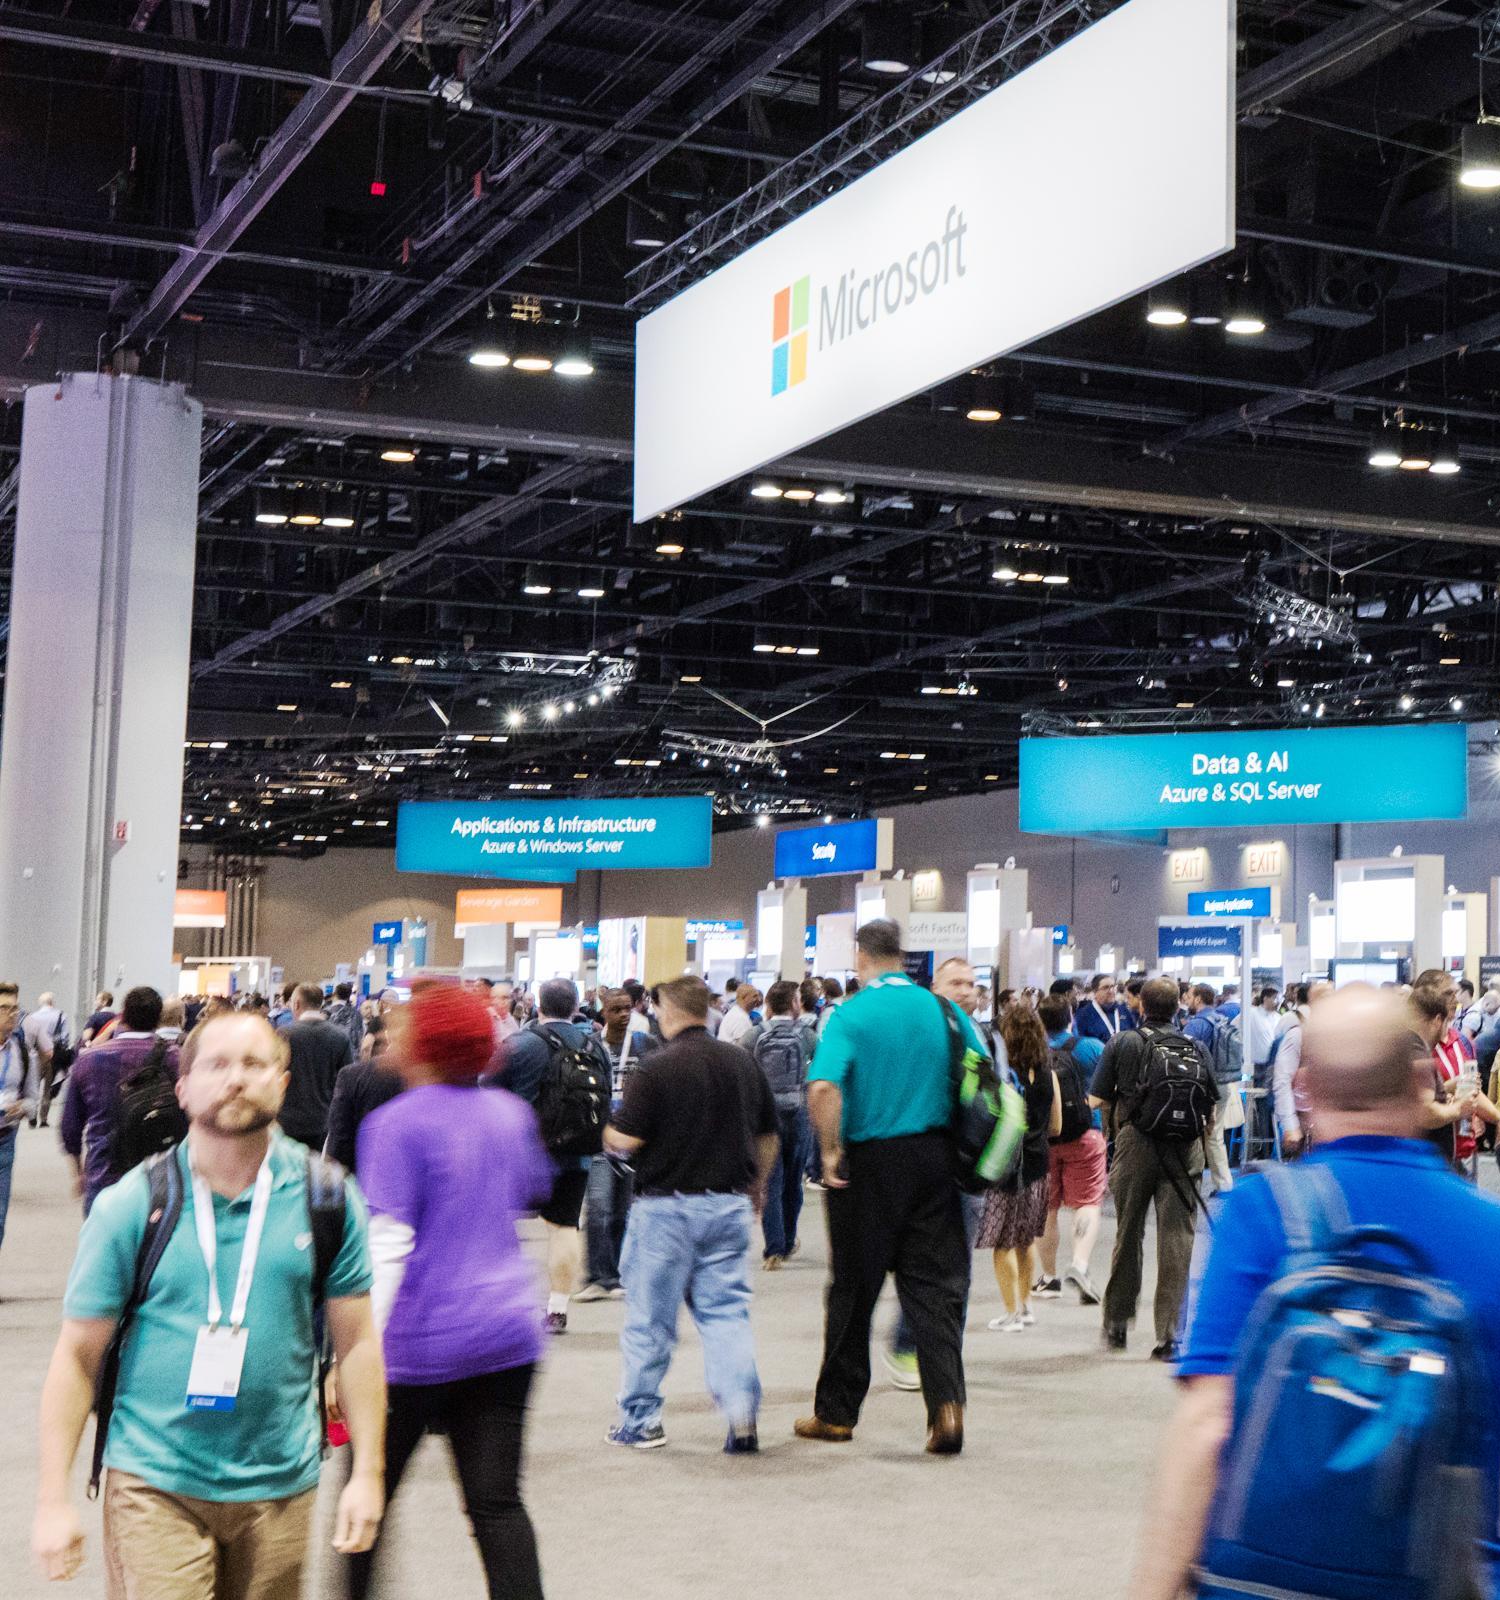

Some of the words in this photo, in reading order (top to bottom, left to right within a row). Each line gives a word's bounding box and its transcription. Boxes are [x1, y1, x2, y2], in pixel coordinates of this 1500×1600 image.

[818, 204, 968, 352] Microsoft
[1192, 753, 1240, 775] Data
[1245, 751, 1262, 774] &
[1266, 750, 1289, 773] AI
[1160, 784, 1209, 803] Azure
[1212, 783, 1226, 801] &
[1229, 781, 1264, 804] SQL
[1267, 781, 1322, 800] Server
[450, 816, 540, 838] Applications
[542, 816, 556, 834] &
[558, 815, 657, 833] Infrastructure
[480, 838, 516, 854] Azure
[517, 838, 529, 854] &
[529, 837, 584, 854] Windows
[585, 837, 624, 853] Server
[1174, 856, 1200, 878] EXIT
[1249, 850, 1278, 873] EXIT
